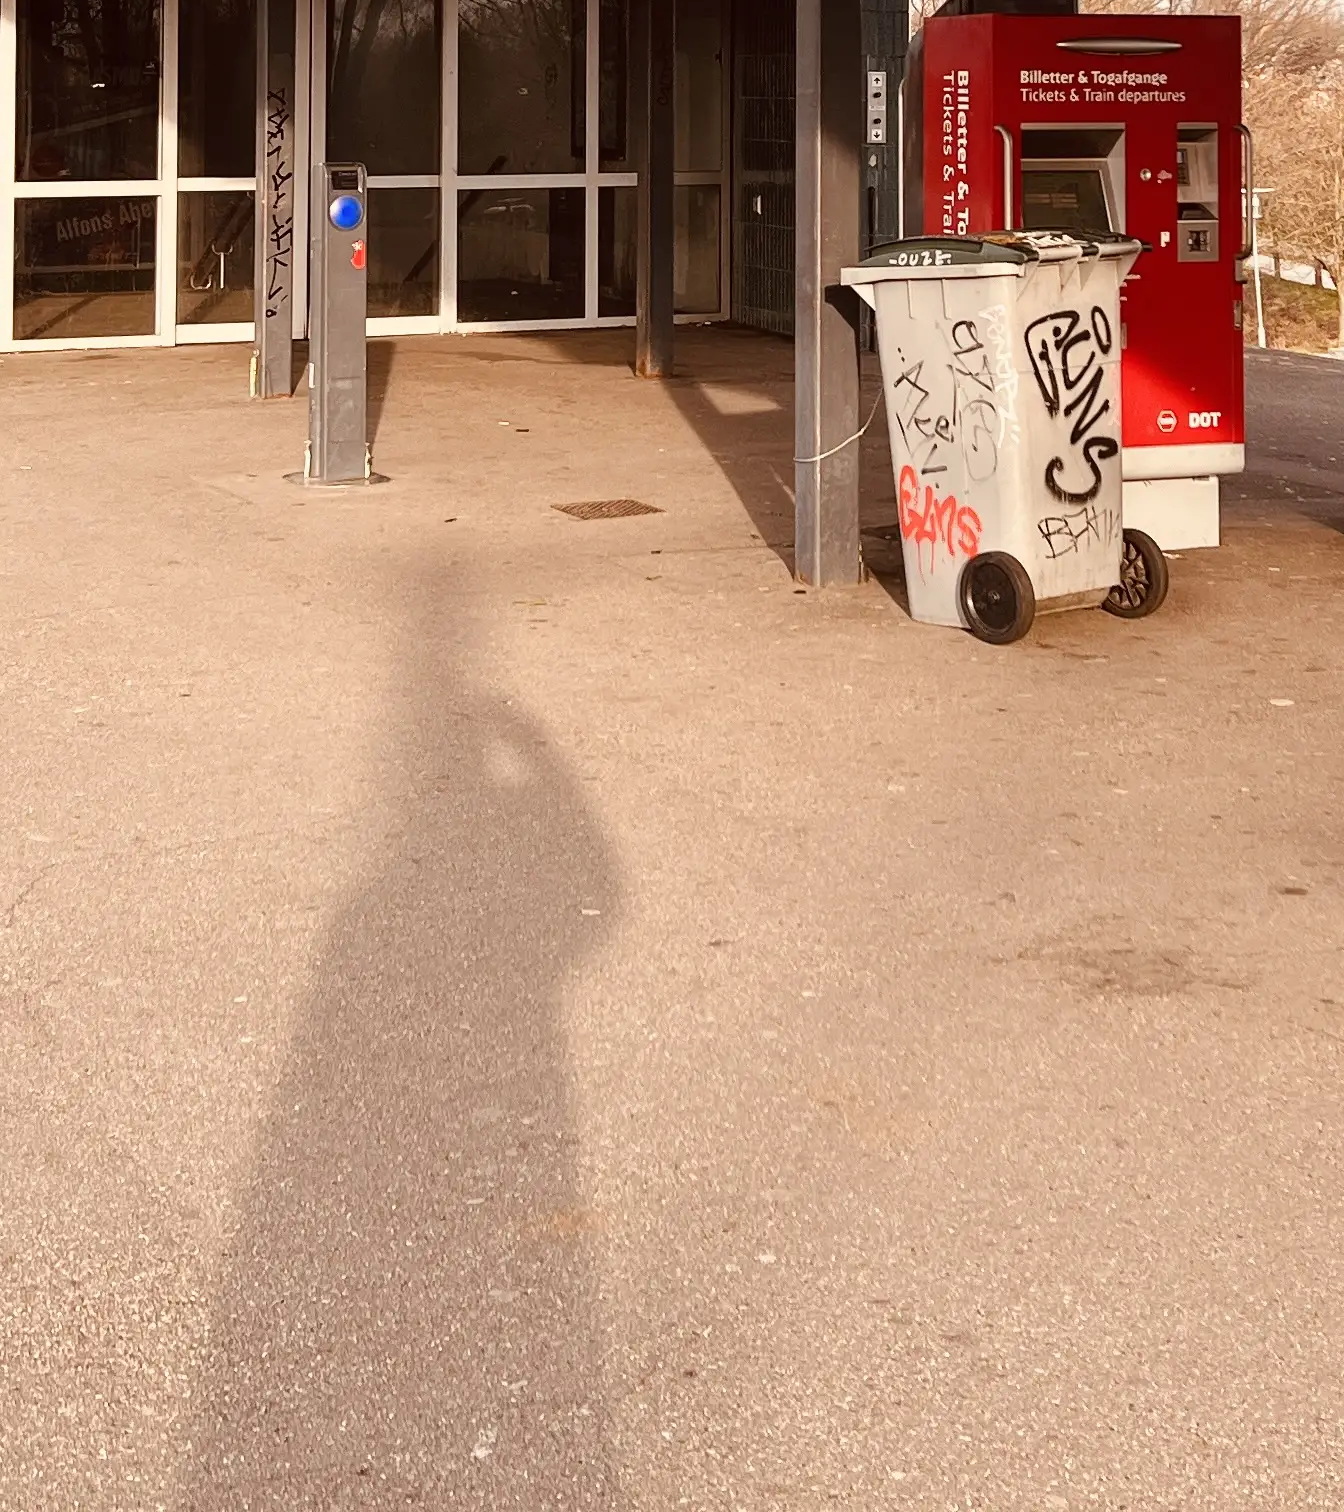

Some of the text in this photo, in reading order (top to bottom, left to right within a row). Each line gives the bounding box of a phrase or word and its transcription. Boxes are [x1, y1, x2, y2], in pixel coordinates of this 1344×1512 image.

[1020, 70, 1168, 86] Billetter & Togafgange
[1020, 88, 1186, 104] Tickets & Train departures
[942, 70, 955, 156] Tickets
[957, 70, 969, 175] Billetter
[942, 164, 955, 182] &
[957, 181, 969, 201] &
[56, 212, 114, 243] Alfons
[1188, 411, 1222, 429] DOT
